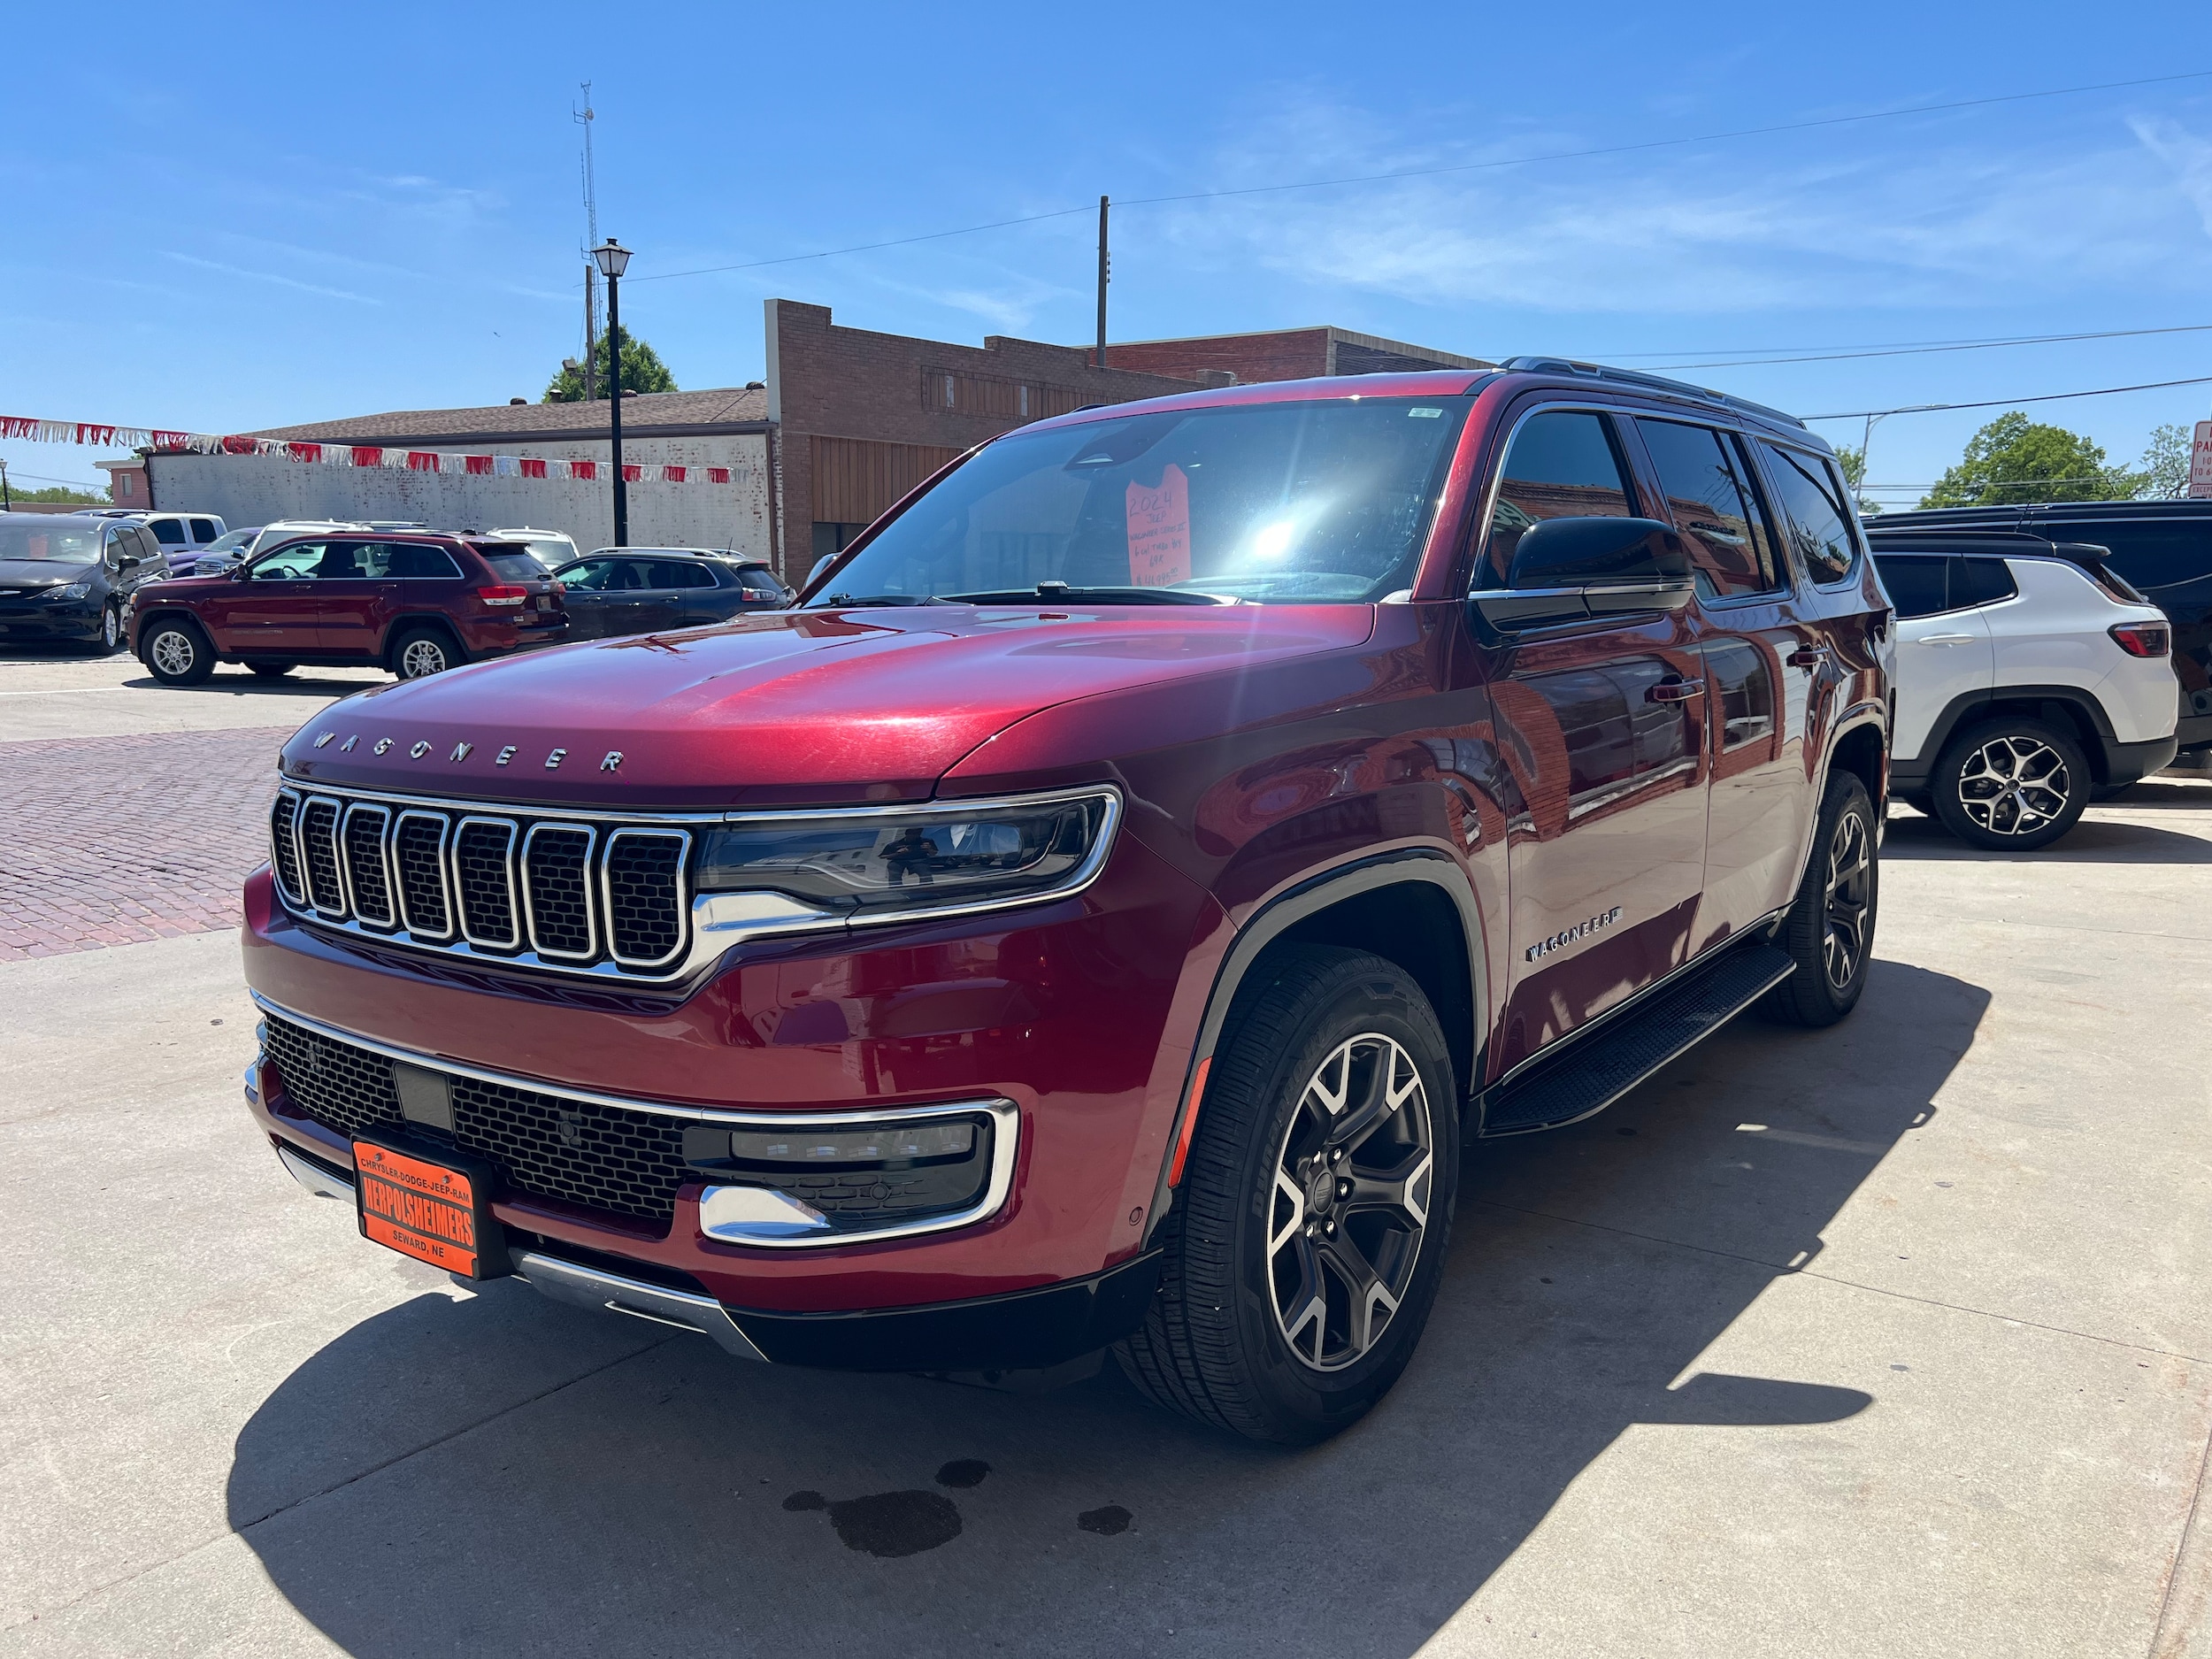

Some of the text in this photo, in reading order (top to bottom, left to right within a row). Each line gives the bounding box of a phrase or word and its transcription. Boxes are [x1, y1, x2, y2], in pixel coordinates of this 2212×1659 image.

[1130, 491, 1172, 517] 2024
[1146, 511, 1167, 524] JEEP
[313, 731, 625, 772] WAGONEER
[1525, 912, 1610, 963] WAGONEER
[361, 1157, 470, 1203] CHRYSLER-DODGE-JEEP-RAM
[364, 1177, 474, 1248] HERPOLSHEIMERS
[393, 1230, 444, 1257] SEWARD, NE
